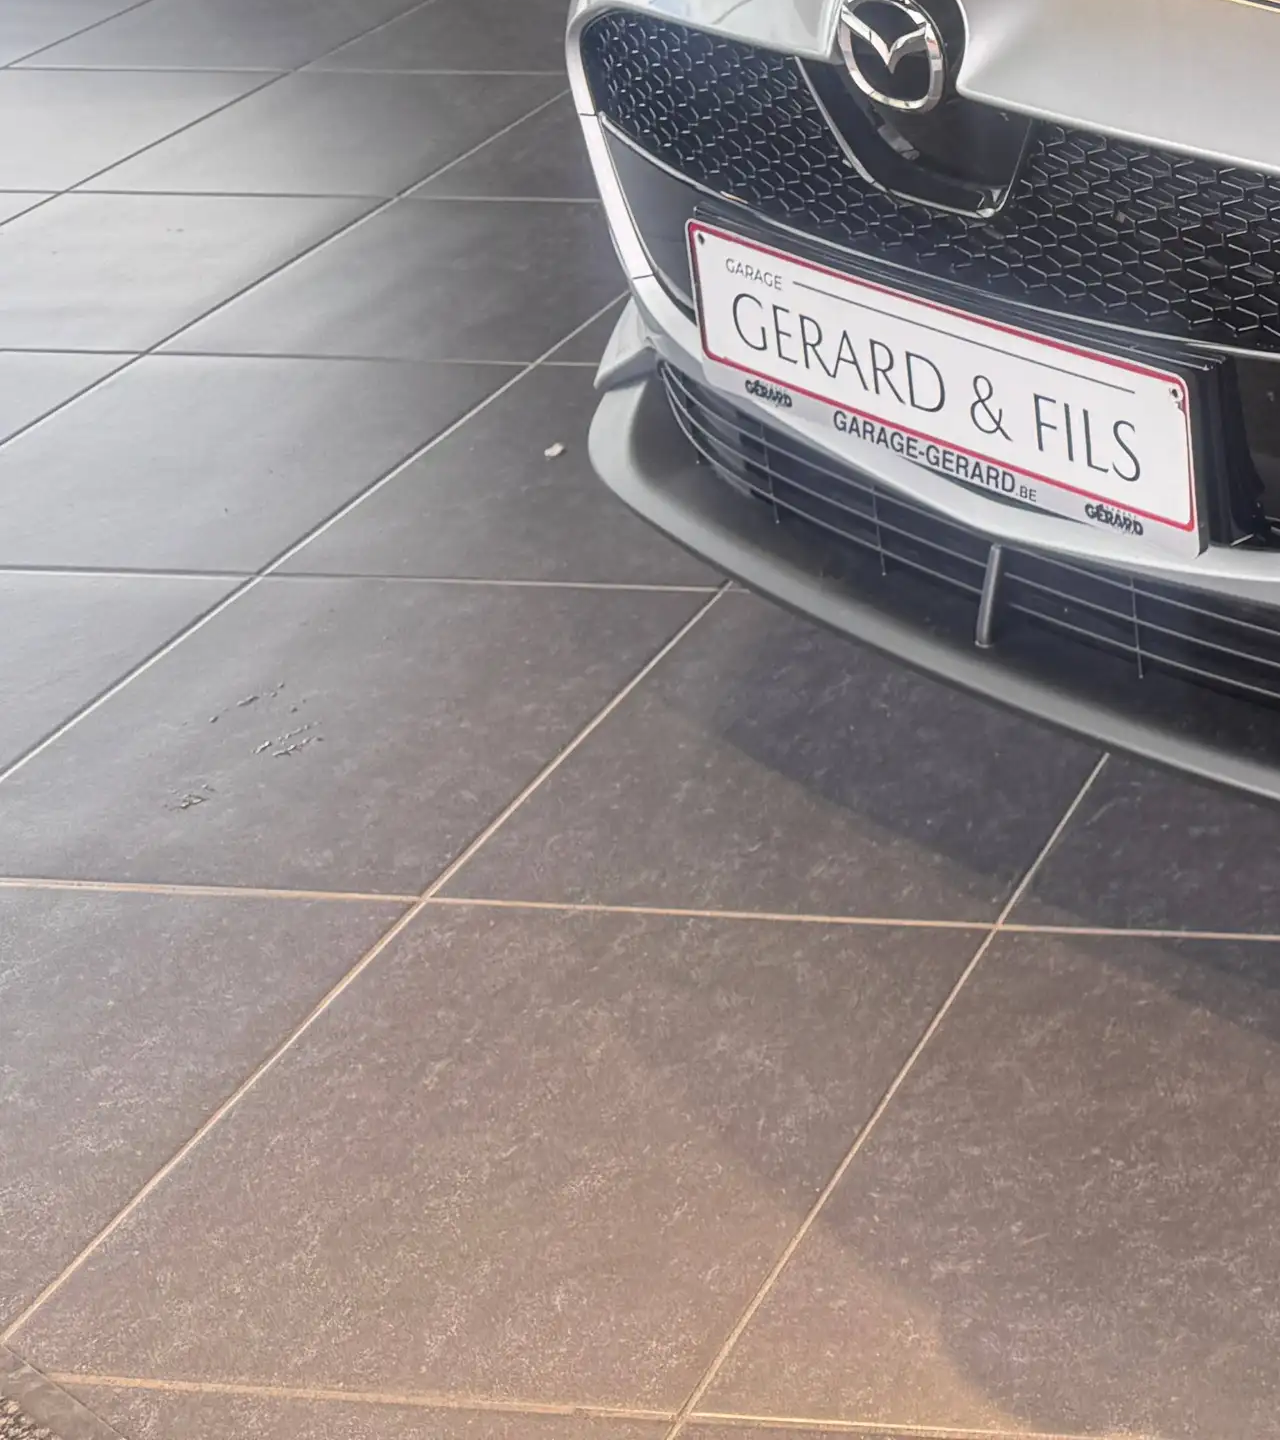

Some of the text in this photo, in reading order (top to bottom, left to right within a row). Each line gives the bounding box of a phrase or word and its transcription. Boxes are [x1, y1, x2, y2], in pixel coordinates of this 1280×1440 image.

[725, 257, 783, 292] GARAGE
[732, 292, 1142, 483] GERARD & FILS
[833, 409, 1038, 503] GARAGE-GERARD.BE
